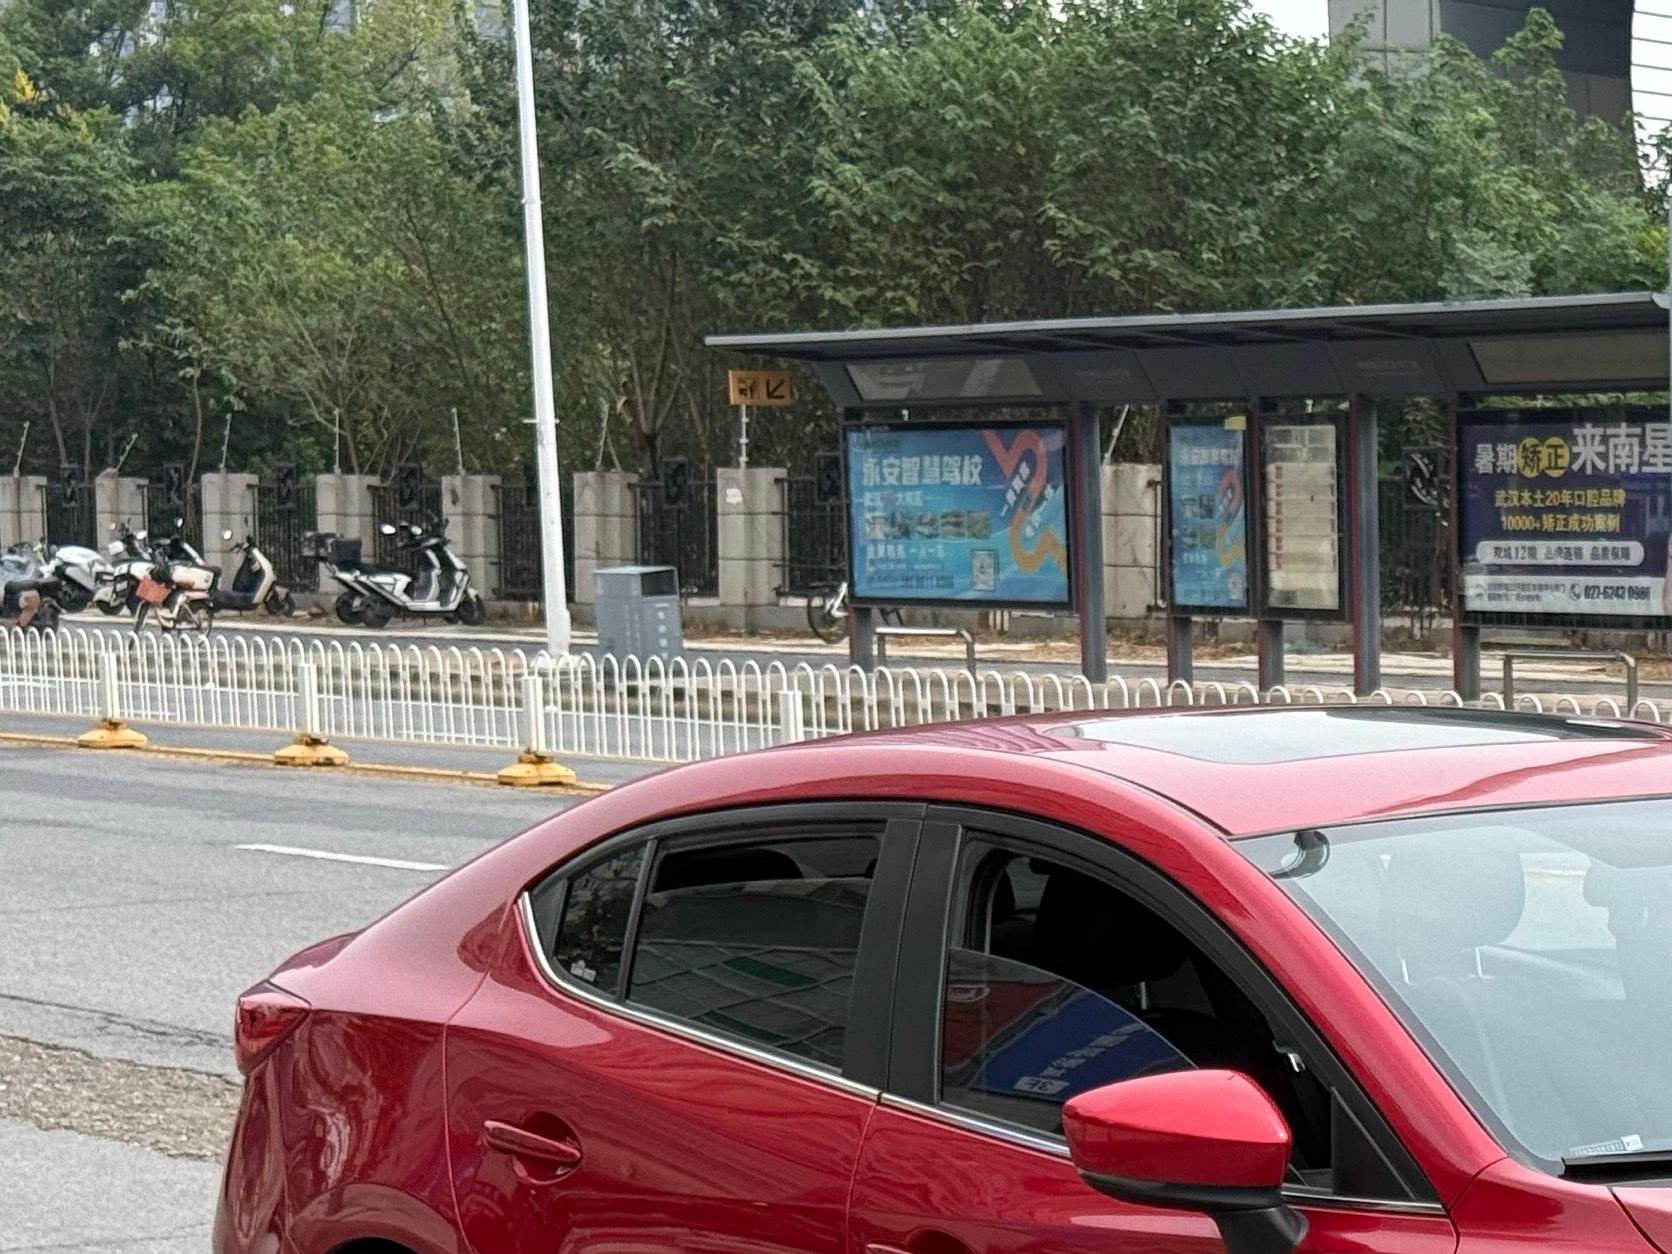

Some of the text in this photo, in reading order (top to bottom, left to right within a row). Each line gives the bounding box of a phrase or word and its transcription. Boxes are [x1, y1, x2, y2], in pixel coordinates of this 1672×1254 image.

[1475, 443, 1566, 474] 暑期矫正
[1494, 488, 1627, 508] 武汉本土20年口腔品牌
[1500, 513, 1621, 532] 10000+矫正成功案例
